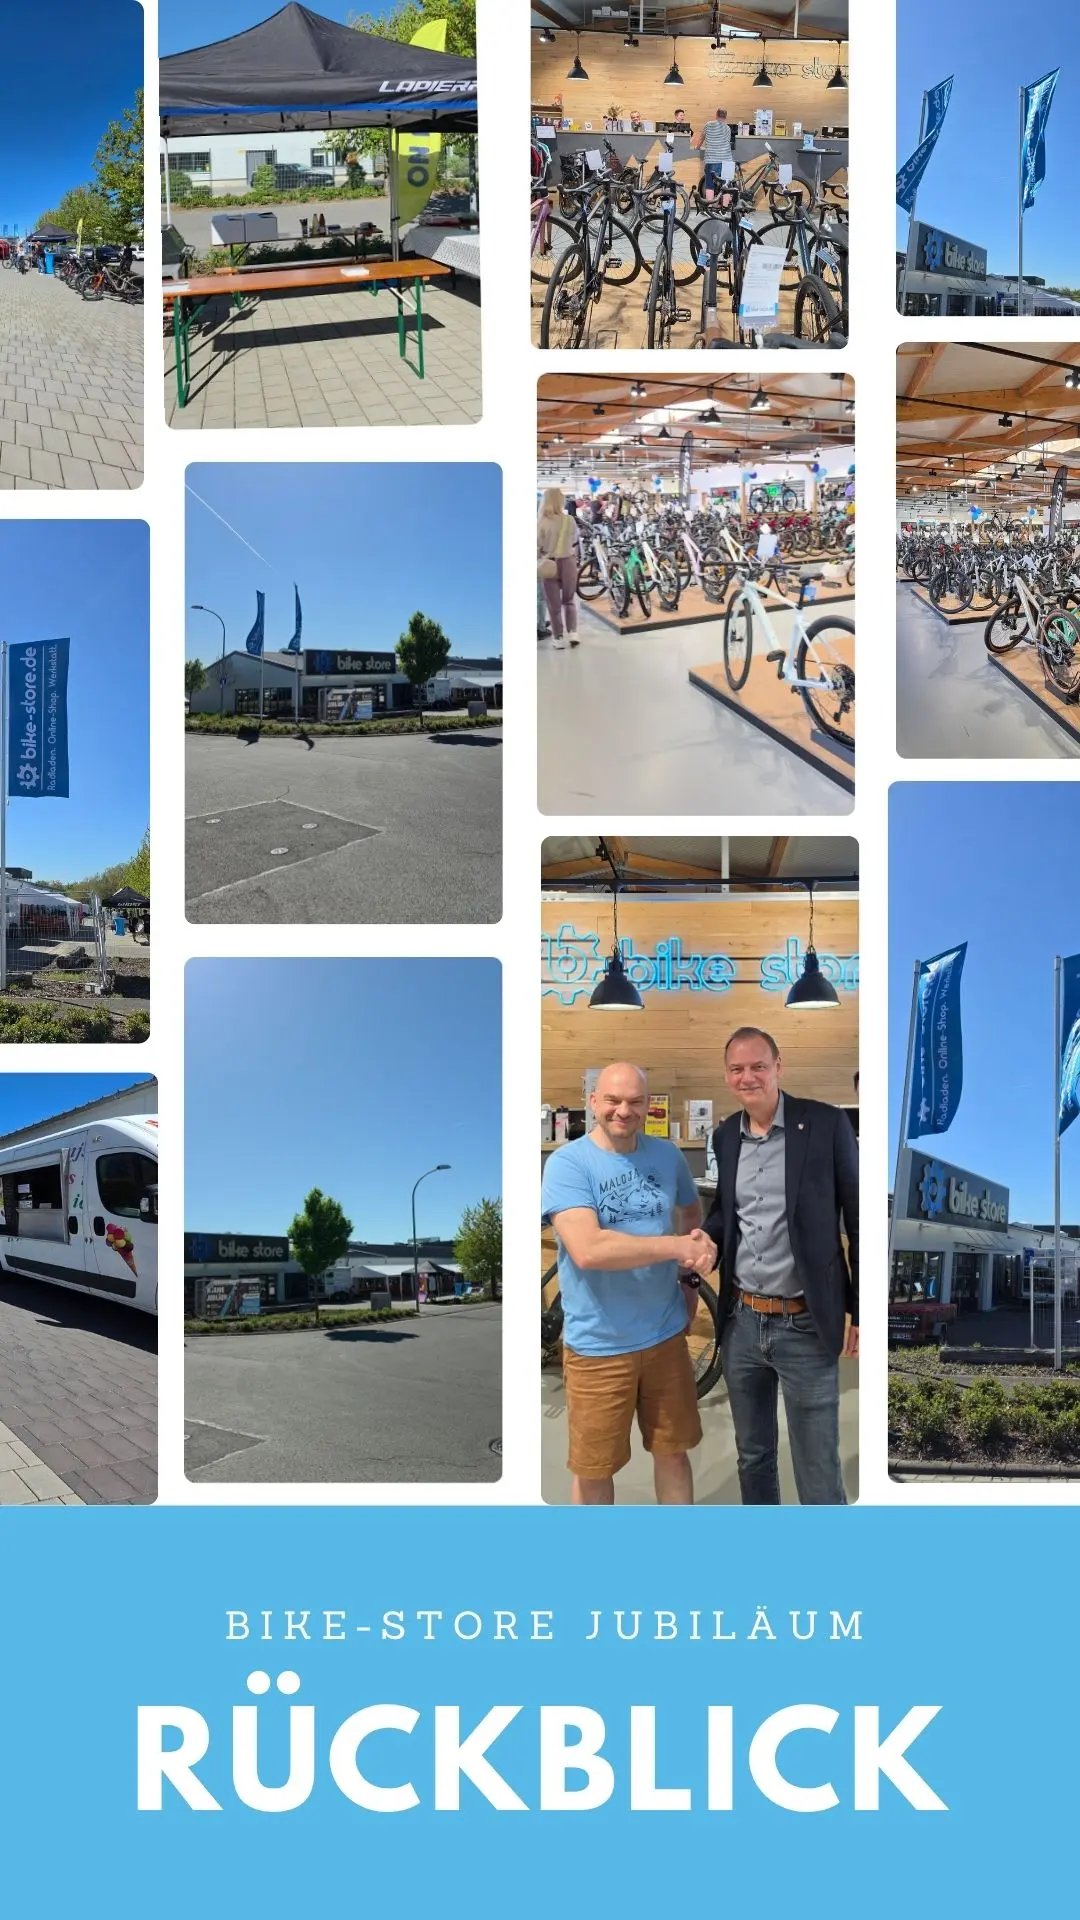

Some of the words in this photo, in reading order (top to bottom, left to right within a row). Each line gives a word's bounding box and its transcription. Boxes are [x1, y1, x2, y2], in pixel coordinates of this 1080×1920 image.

[945, 241, 966, 271] bike
[966, 249, 985, 275] store
[337, 655, 362, 670] bike
[366, 656, 391, 670] store
[20, 646, 37, 760] bike-store.de
[47, 690, 59, 744] Online-Shop.
[936, 1001, 951, 1070] Online-Shop.
[599, 1168, 641, 1195] MALOJA
[950, 1177, 979, 1218] bike
[980, 1190, 1006, 1223] store
[218, 1239, 250, 1258] bike
[252, 1241, 284, 1258] store
